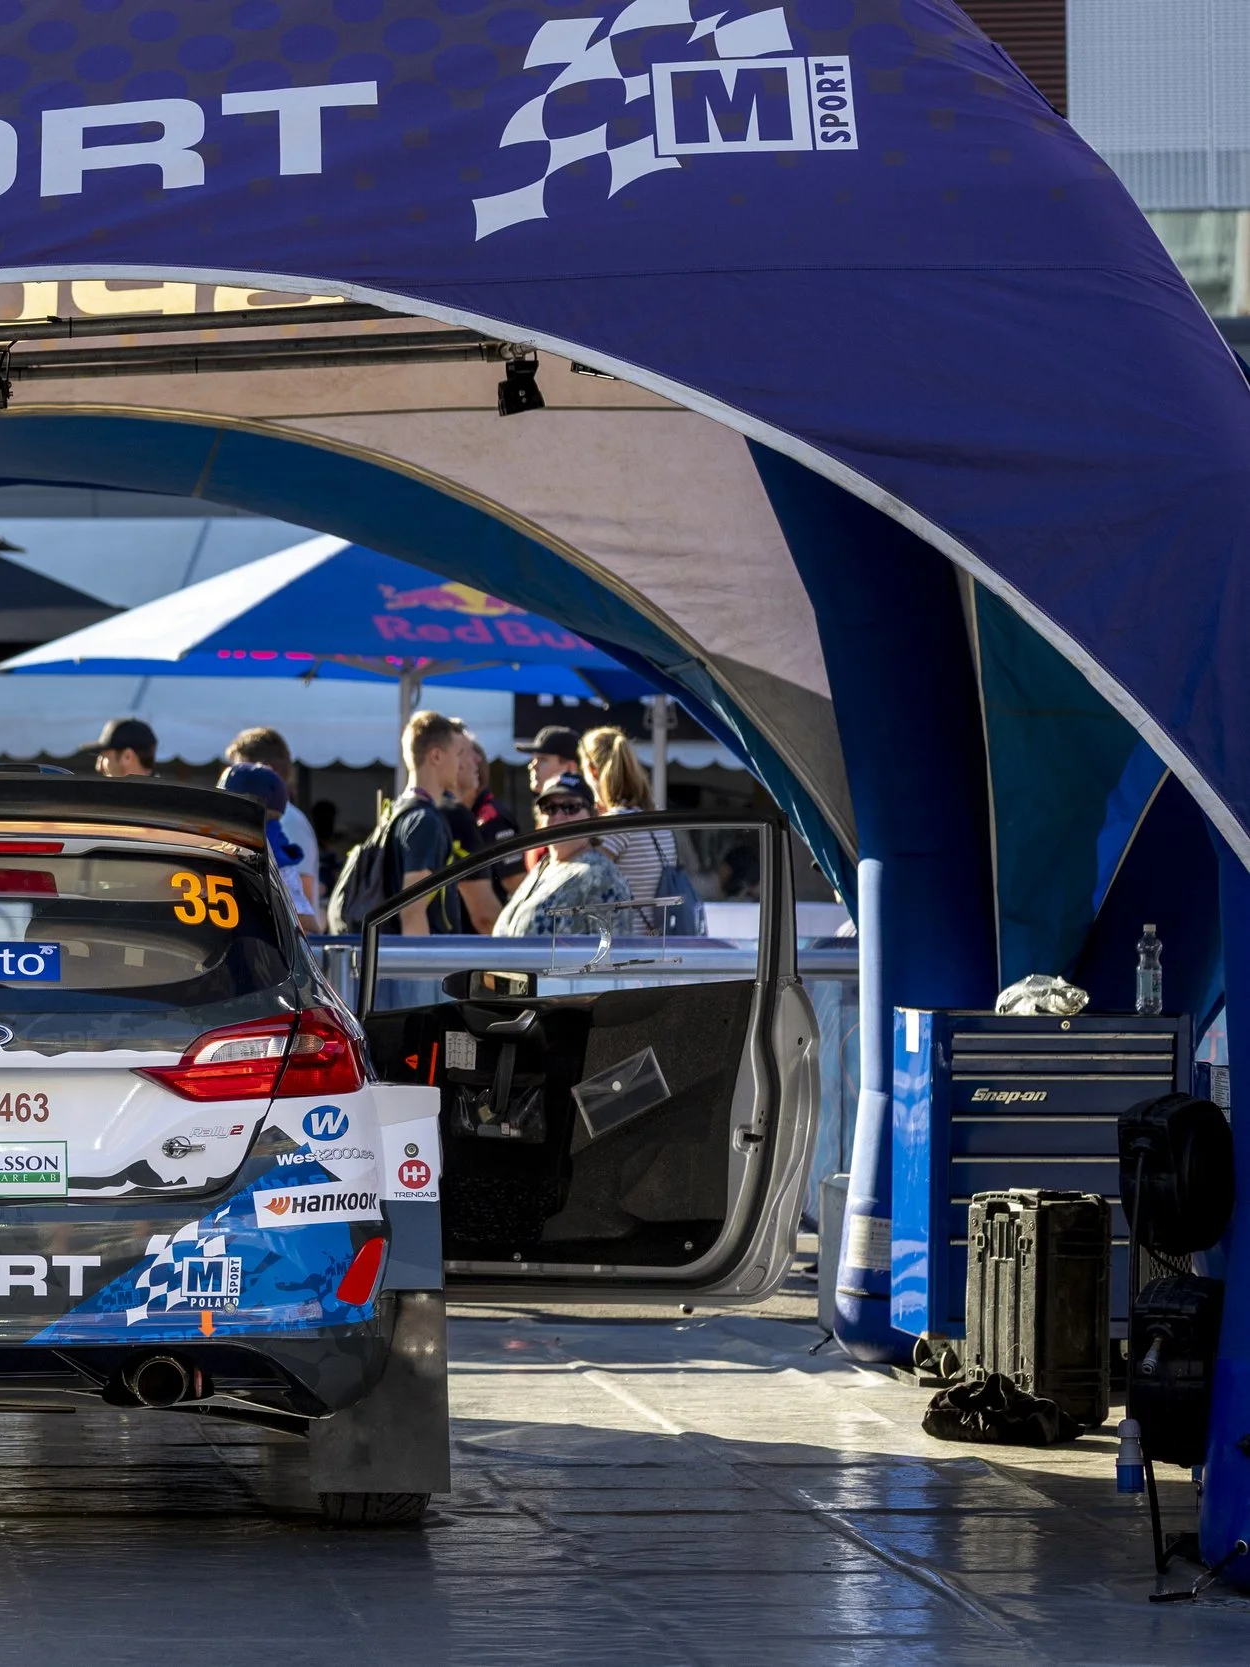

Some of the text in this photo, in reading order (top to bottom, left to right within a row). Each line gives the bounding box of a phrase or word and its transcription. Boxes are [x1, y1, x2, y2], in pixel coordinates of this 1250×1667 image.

[670, 66, 794, 144] M
[814, 62, 851, 143] SPORT
[372, 614, 494, 644] Red
[171, 872, 239, 929] 35
[971, 1087, 1048, 1104] Snap-on
[38, 1173, 57, 1182] AB
[187, 1261, 223, 1292] M
[229, 1260, 240, 1294] SPORT
[190, 1297, 240, 1308] POLAND
